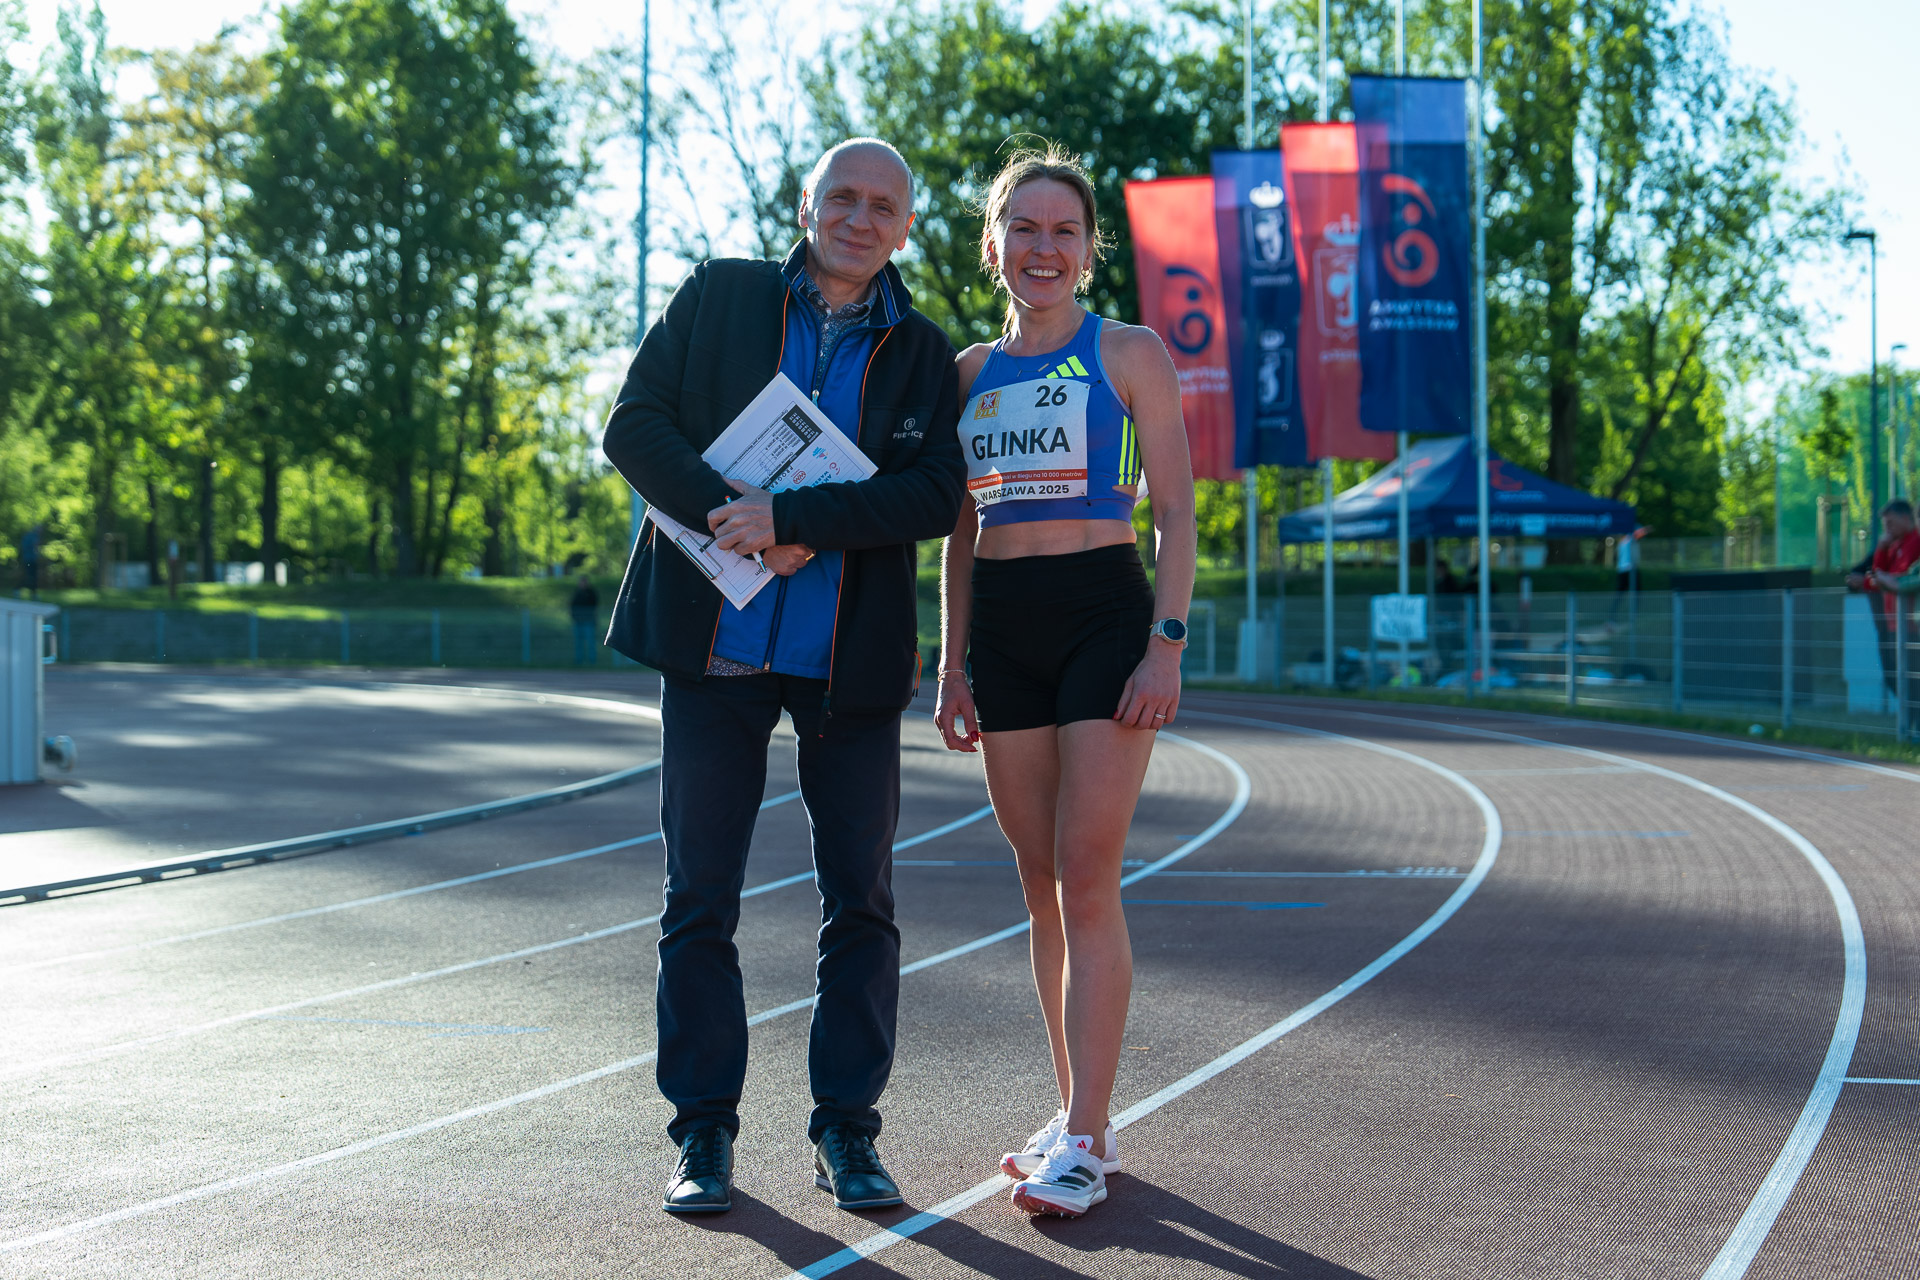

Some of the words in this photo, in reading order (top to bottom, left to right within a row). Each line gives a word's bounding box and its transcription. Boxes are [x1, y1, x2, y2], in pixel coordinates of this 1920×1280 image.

[1034, 384, 1067, 408] 26
[971, 427, 1071, 461] GLINKA
[980, 485, 1036, 501] WARSZAWA
[1038, 484, 1070, 495] 2025
